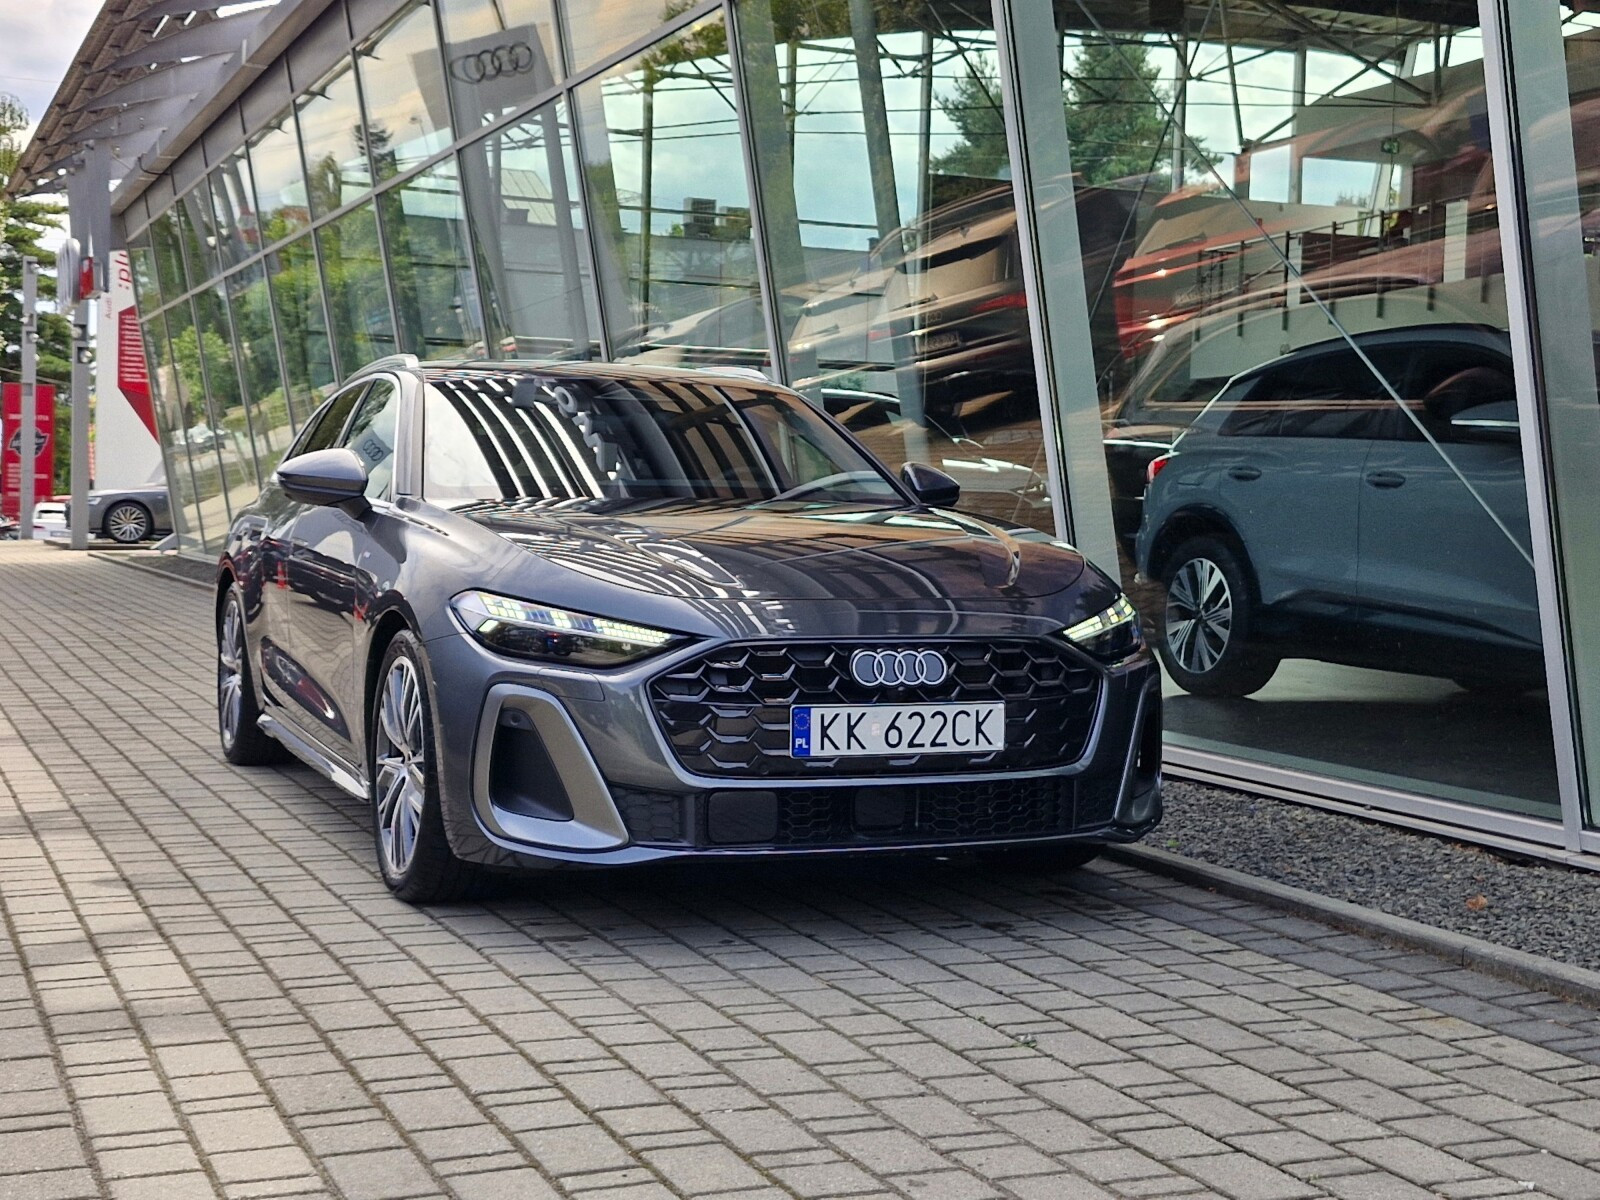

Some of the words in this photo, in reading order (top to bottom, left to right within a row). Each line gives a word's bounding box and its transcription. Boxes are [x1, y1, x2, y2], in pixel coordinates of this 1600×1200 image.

[820, 712, 866, 750] KK
[884, 709, 994, 749] 622CK
[795, 738, 808, 749] PL
